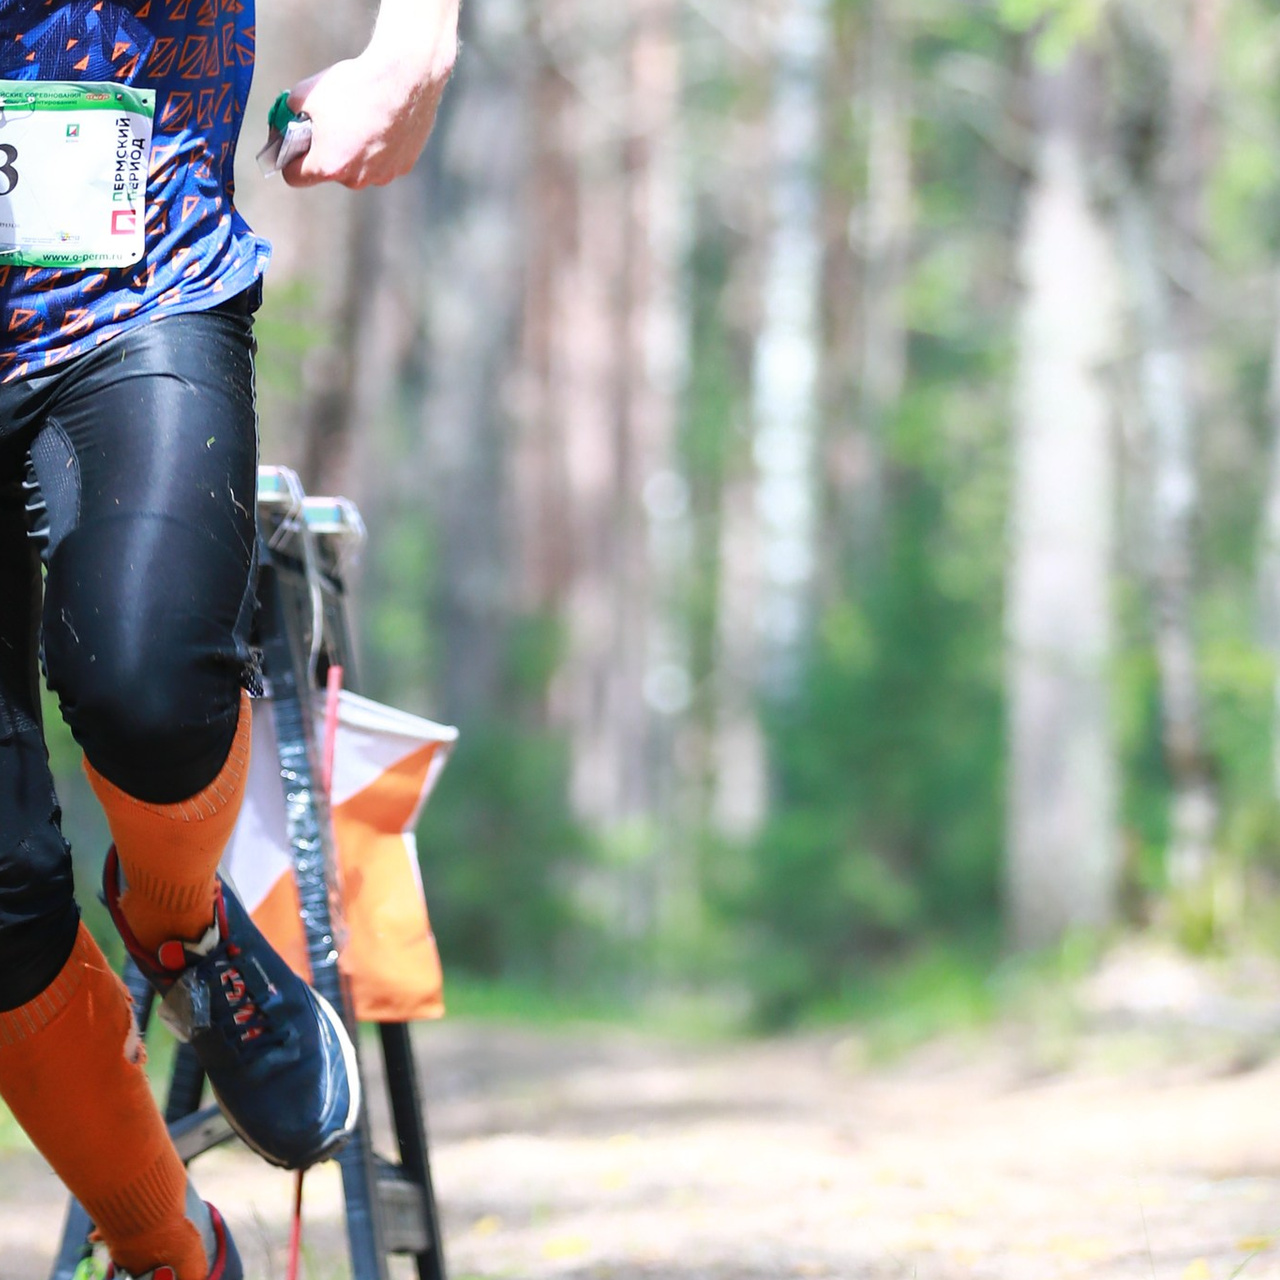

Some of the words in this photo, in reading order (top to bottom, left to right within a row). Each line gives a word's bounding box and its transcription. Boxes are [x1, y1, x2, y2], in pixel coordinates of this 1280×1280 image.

[25, 91, 82, 99] СОРЕВНОВАНИЯ
[112, 117, 131, 201] ПЕРМСКИЙ
[127, 138, 146, 202] ПЕРИОД
[43, 253, 123, 262] www.o-perm.ru
